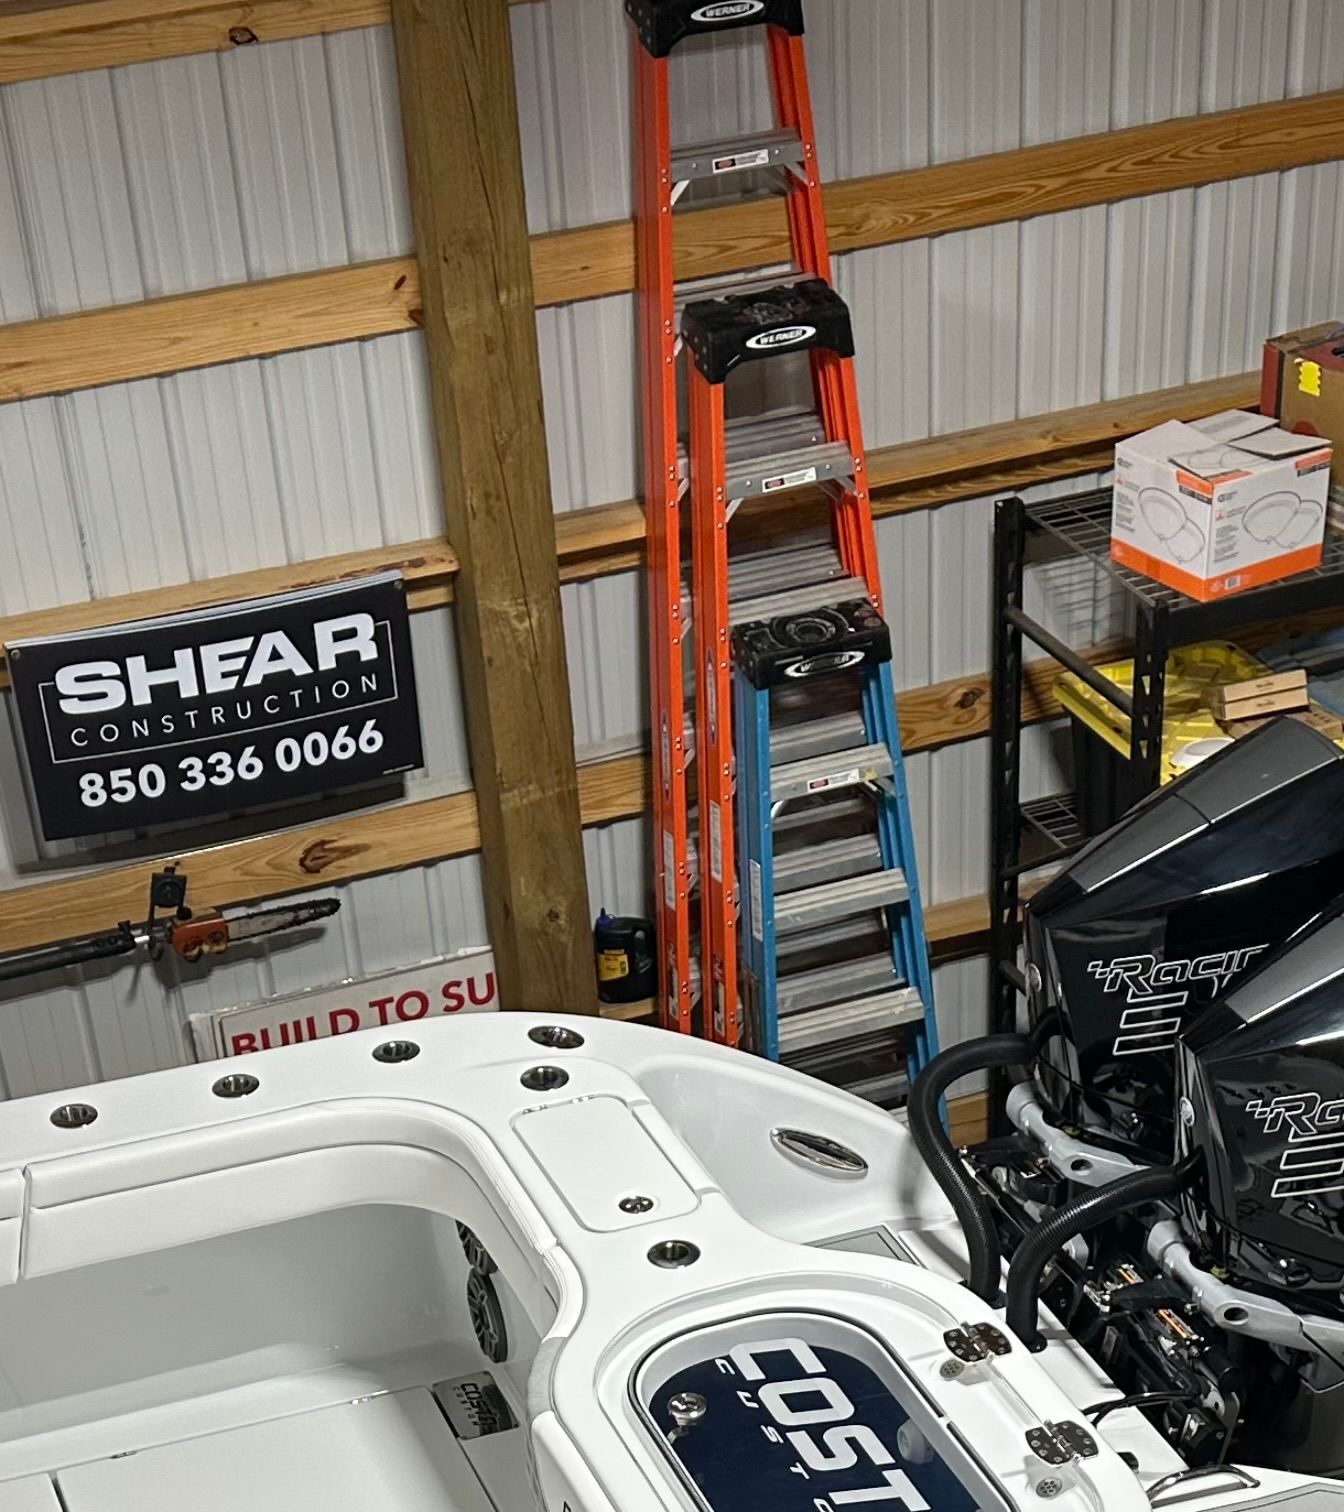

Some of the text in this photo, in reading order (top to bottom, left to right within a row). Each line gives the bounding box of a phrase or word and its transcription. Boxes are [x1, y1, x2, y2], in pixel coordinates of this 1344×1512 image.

[706, 2, 751, 17] WERNER
[759, 328, 803, 345] WERNER
[55, 613, 379, 715] SHEAR
[71, 673, 378, 747] CONSTRUCTION
[78, 718, 384, 807] 850 336 0066
[369, 990, 430, 1027] TO
[441, 972, 496, 1012] SU
